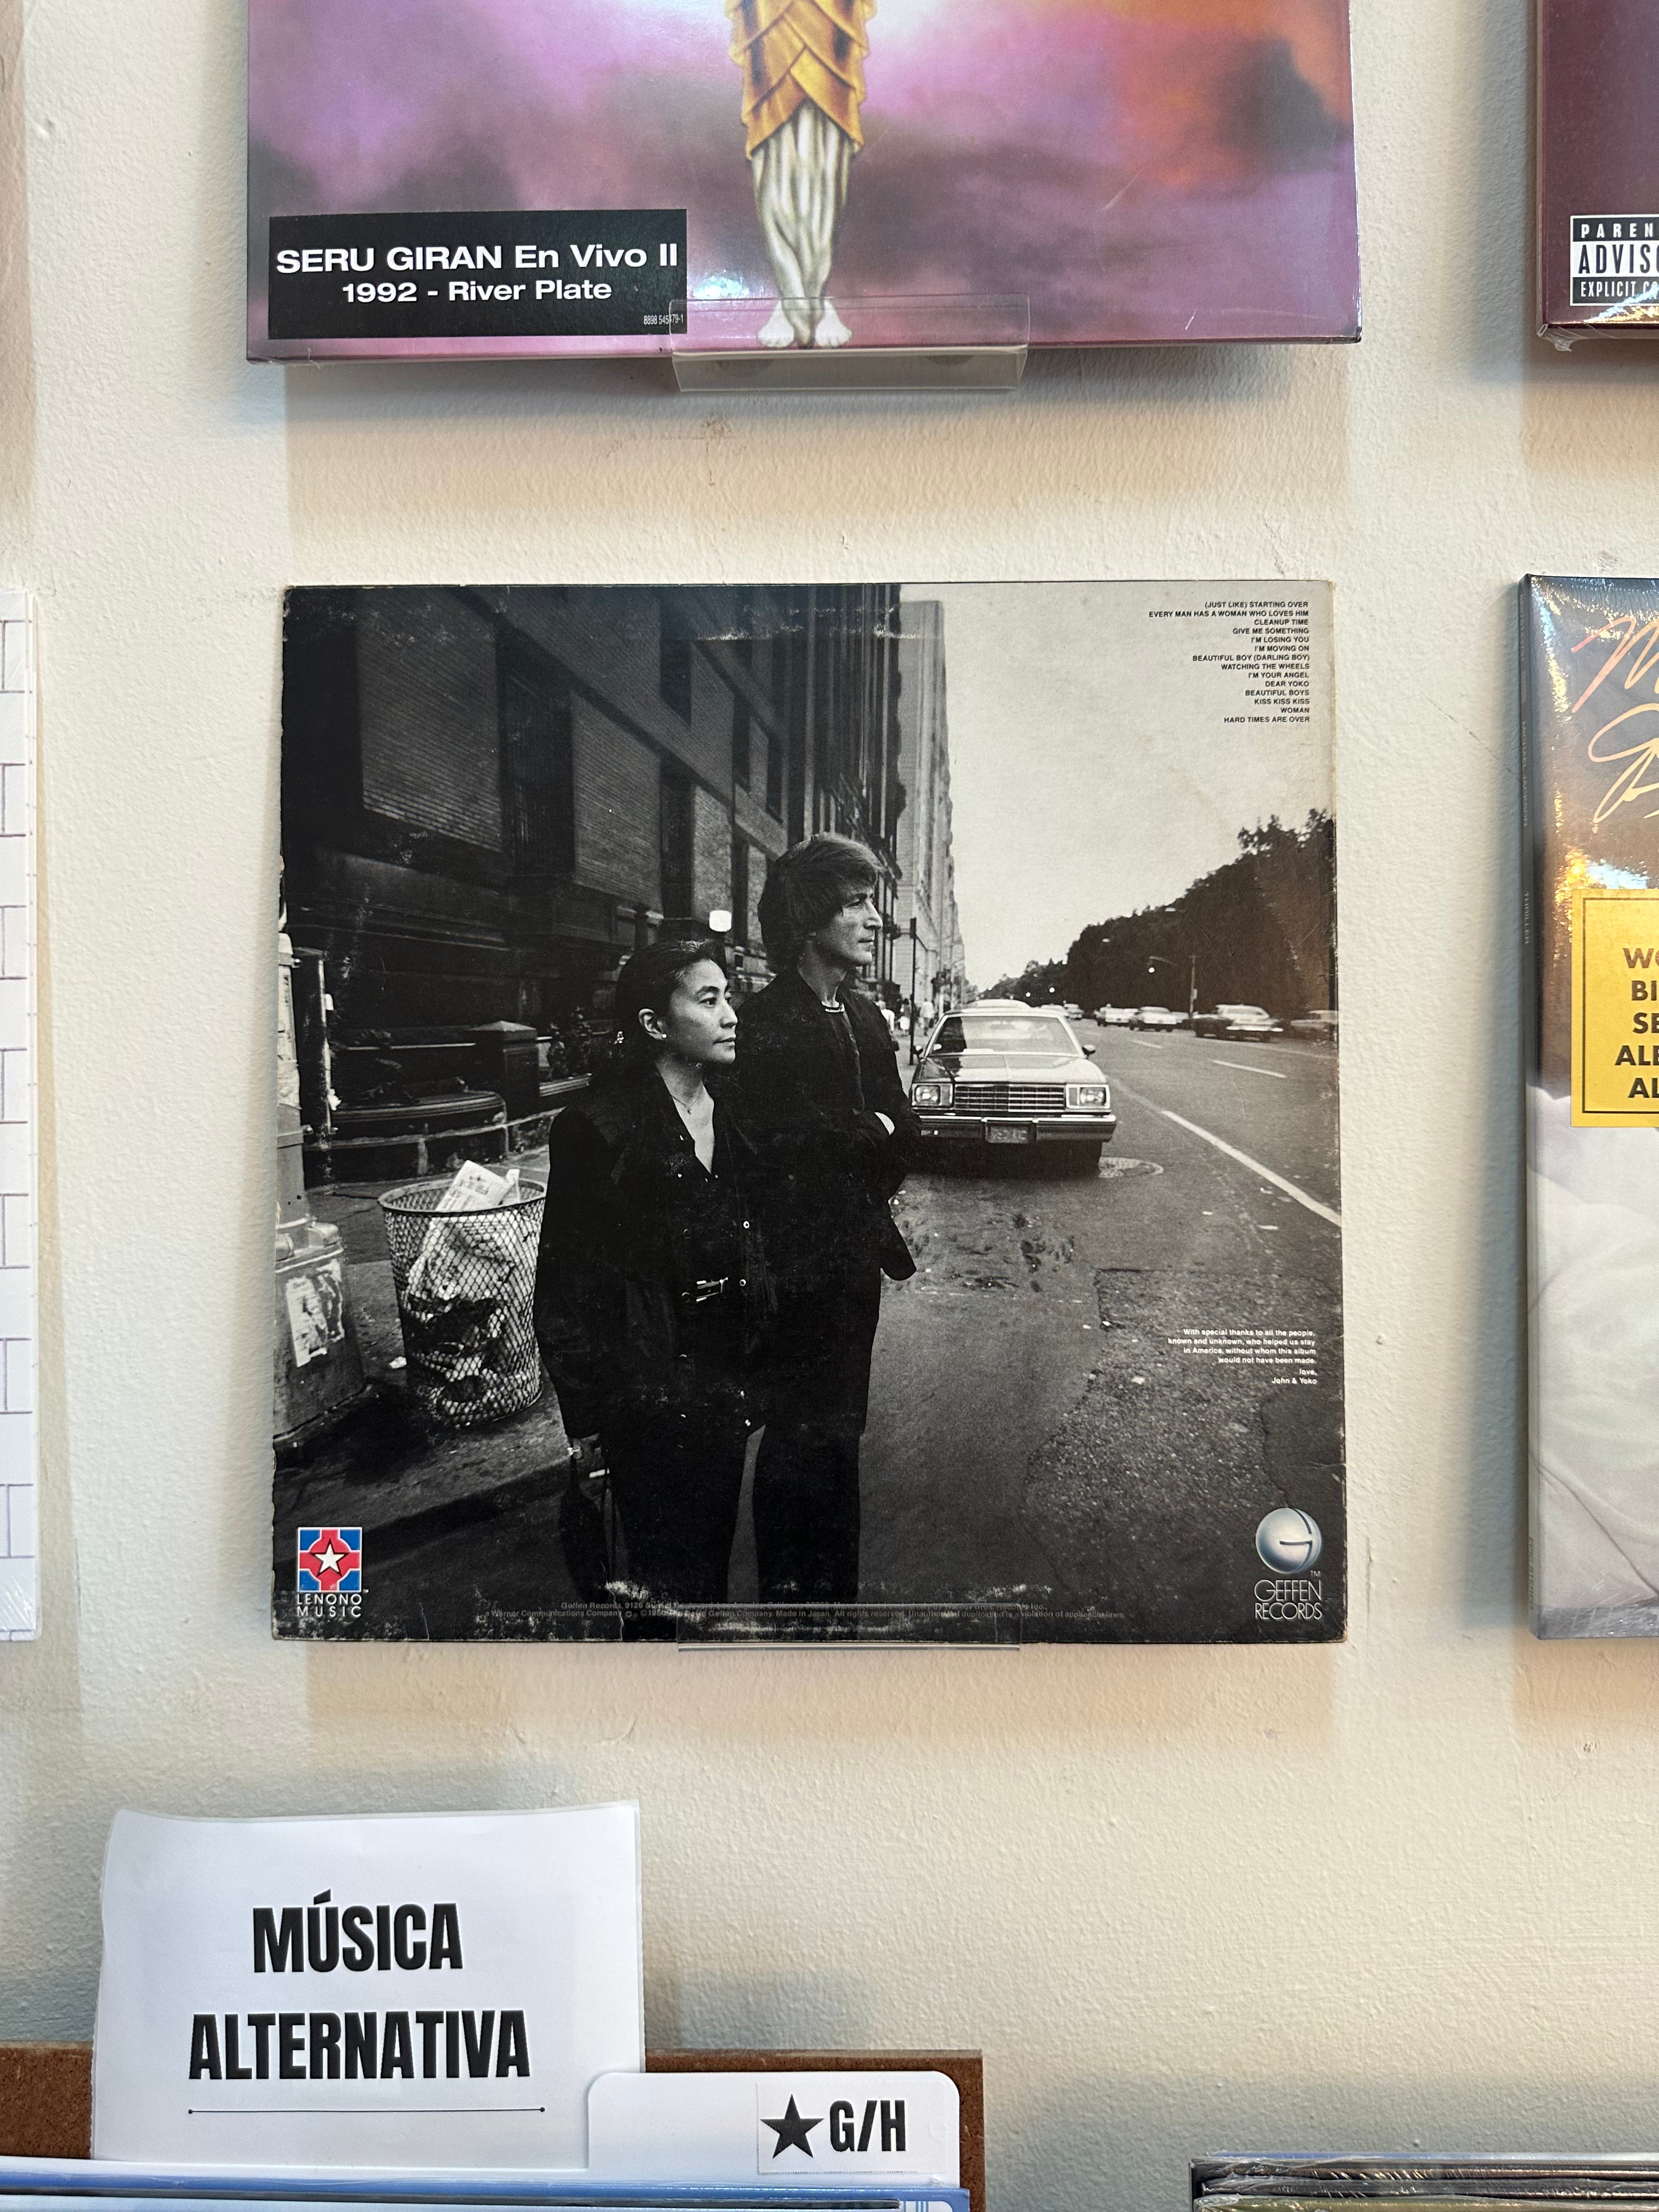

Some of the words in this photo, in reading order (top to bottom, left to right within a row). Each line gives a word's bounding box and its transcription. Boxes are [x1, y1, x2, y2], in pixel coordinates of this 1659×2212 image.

[276, 248, 374, 274] SERU
[387, 245, 503, 271] GIRAN
[515, 246, 559, 268] En
[570, 244, 647, 268] Vivo
[659, 243, 679, 267] II
[1578, 244, 1659, 274] ADVIS
[342, 283, 417, 303] 1992
[449, 280, 526, 301] River
[535, 279, 612, 300] Plate
[1581, 281, 1637, 297] EXPLICIT
[1622, 948, 1659, 969] W
[1201, 1329, 1228, 1337] special
[1263, 1338, 1288, 1346] helped
[297, 1593, 362, 1605] LENONO
[1254, 1579, 1322, 1602] GEFFEN
[297, 1605, 362, 1617] MUSIC
[847, 1610, 868, 1618] rights
[1255, 1602, 1323, 1620] RECORDS
[252, 1889, 463, 1974] MÚSICA
[189, 2010, 530, 2080] ALTERNATIVA
[830, 2099, 906, 2153] G/H
